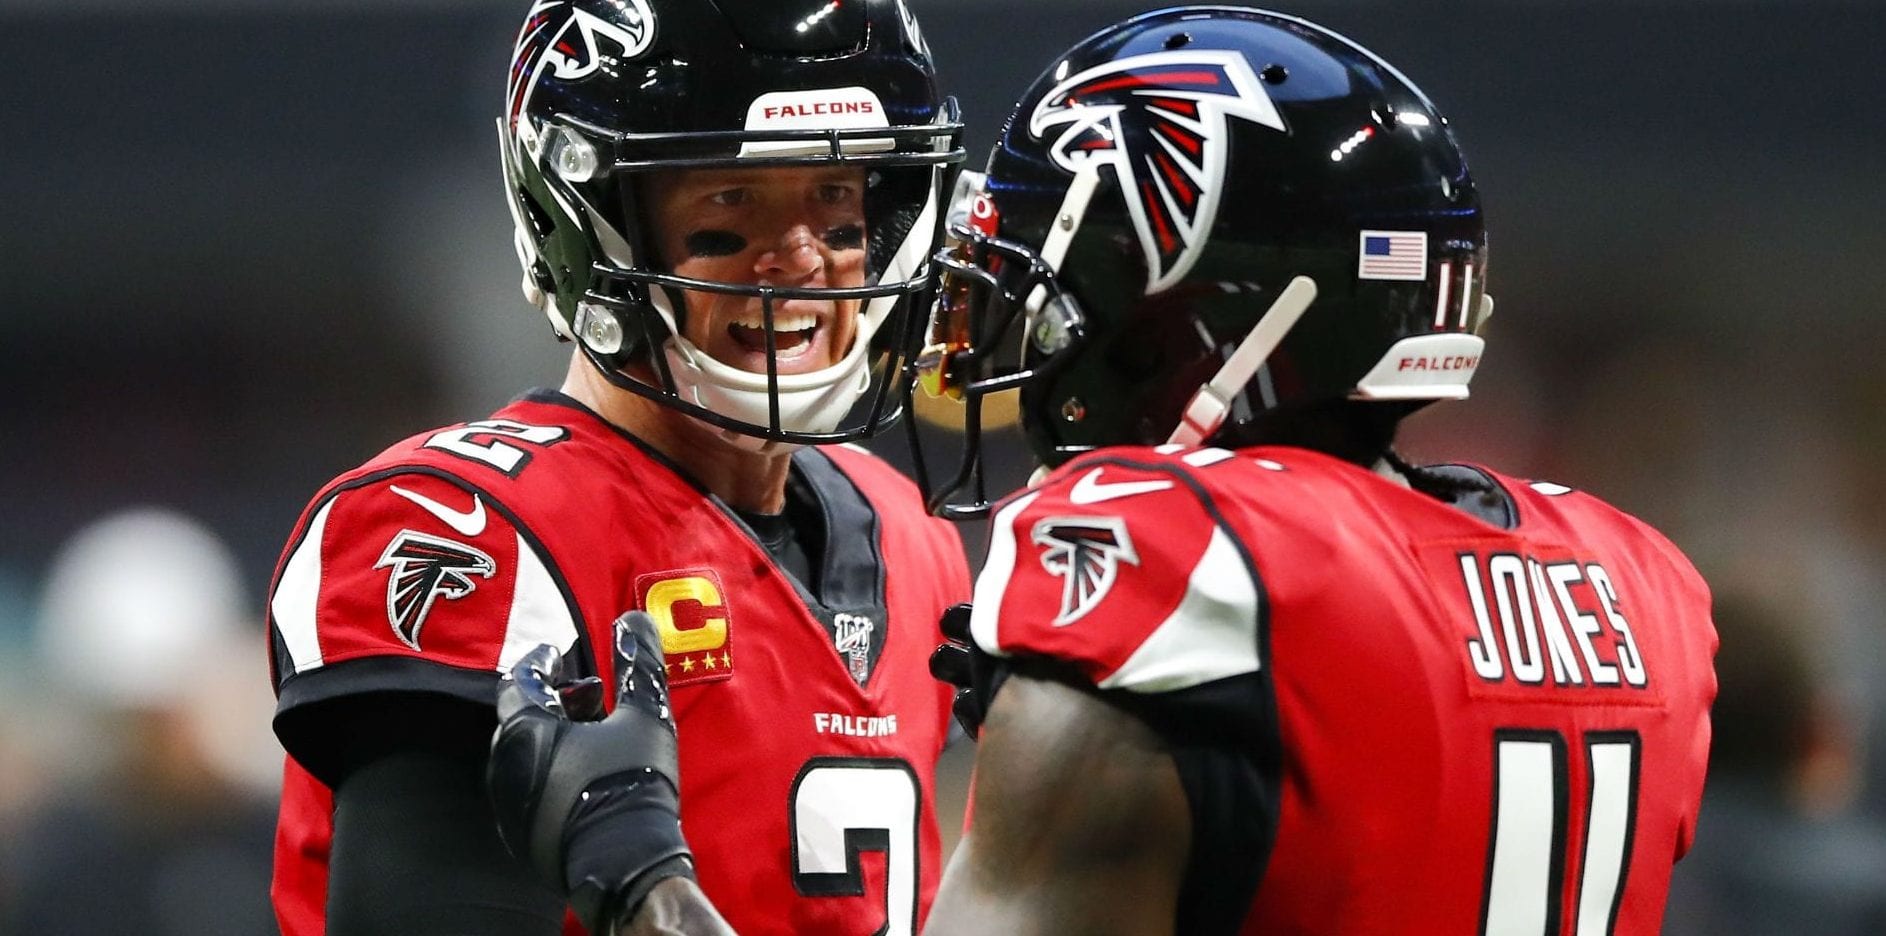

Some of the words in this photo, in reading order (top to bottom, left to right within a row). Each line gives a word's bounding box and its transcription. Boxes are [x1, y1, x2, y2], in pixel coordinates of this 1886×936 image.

[764, 102, 873, 119] FALCONS
[1433, 260, 1474, 332] 11
[417, 419, 571, 479] 2
[645, 577, 728, 654] C
[1456, 551, 1649, 688] JONES
[812, 713, 897, 737] FALCONS
[788, 756, 922, 936] 2
[1479, 728, 1642, 936] 11
